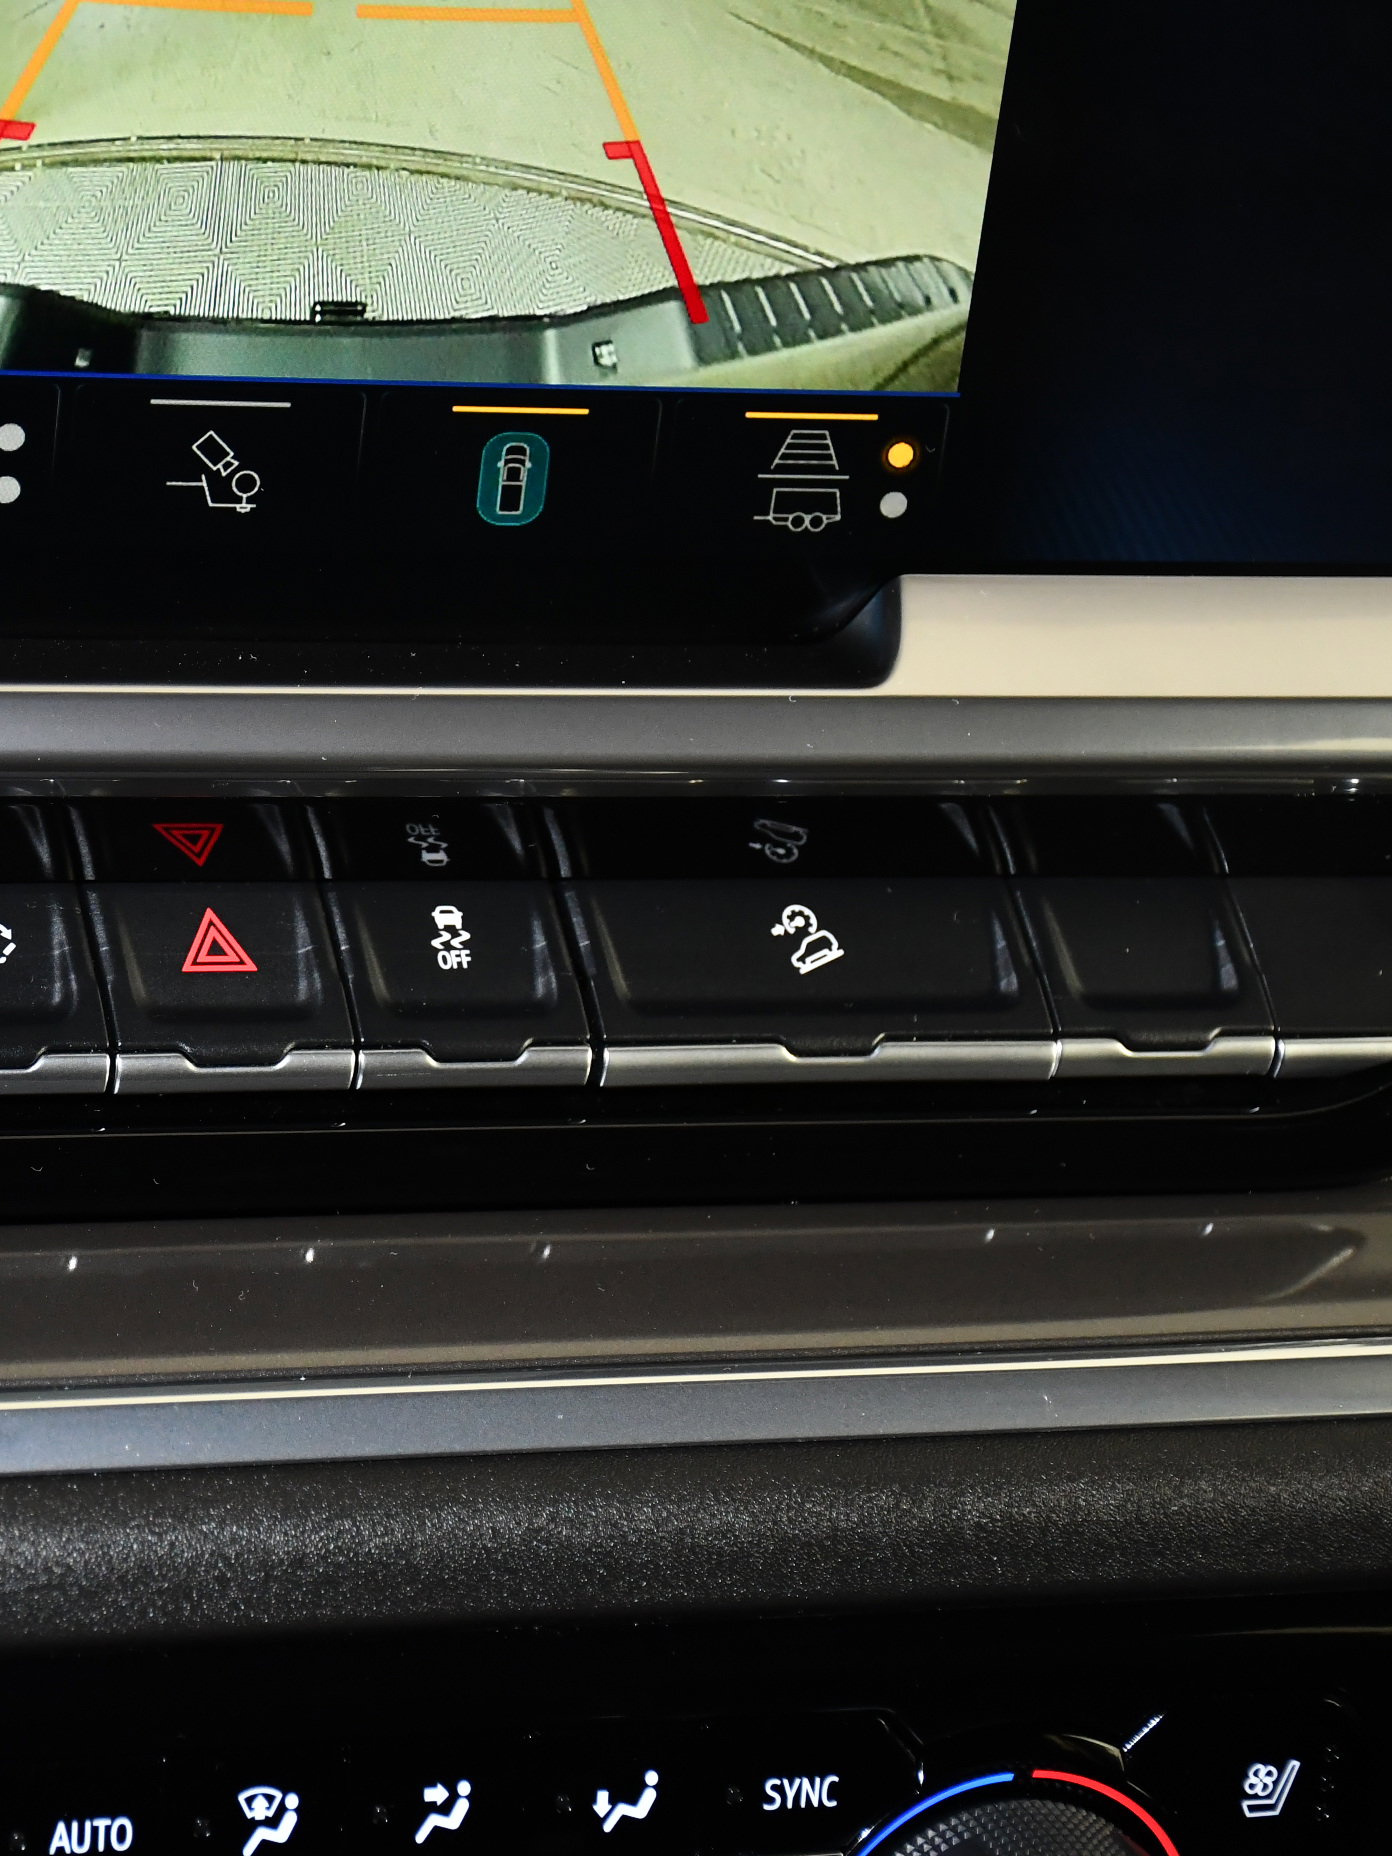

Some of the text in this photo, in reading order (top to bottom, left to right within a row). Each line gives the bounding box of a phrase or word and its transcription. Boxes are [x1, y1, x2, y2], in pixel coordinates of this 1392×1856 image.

[437, 949, 472, 970] OFF
[763, 1774, 840, 1811] SYNC
[49, 1816, 133, 1855] AUTO
